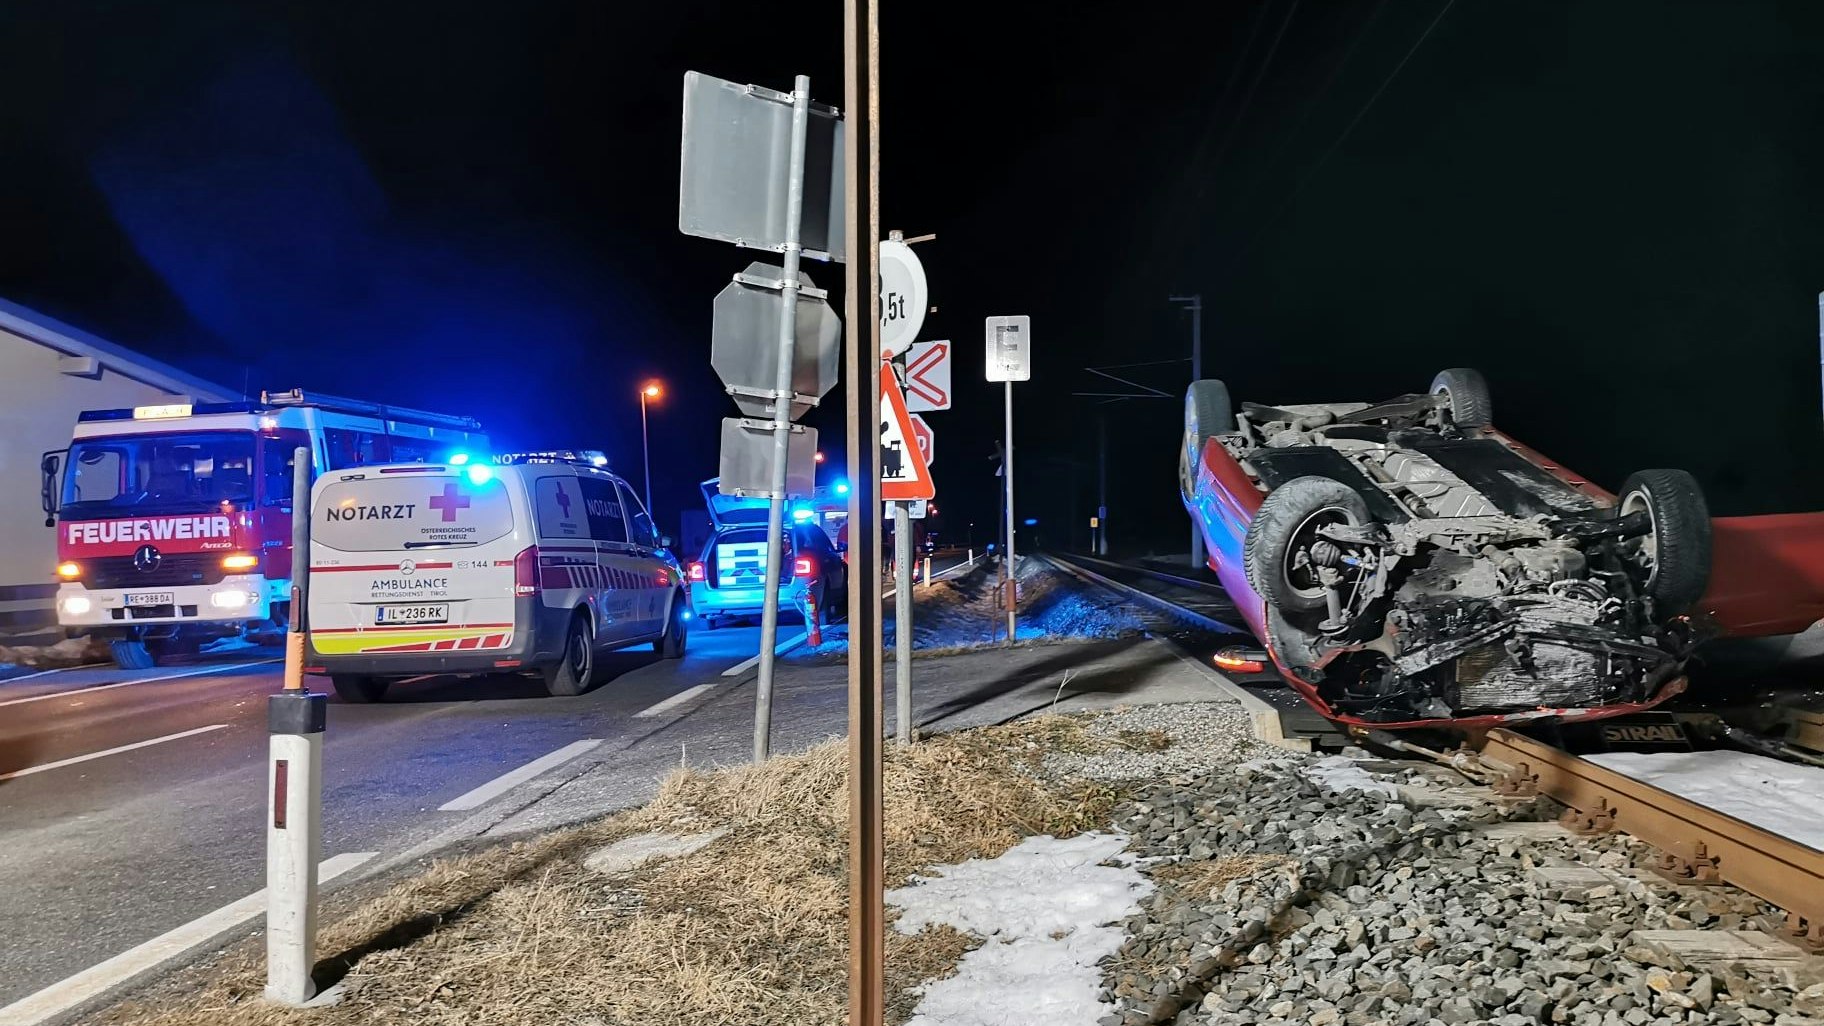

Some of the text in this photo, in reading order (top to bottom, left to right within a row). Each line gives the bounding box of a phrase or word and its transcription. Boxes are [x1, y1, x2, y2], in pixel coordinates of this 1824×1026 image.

[327, 504, 415, 522] NOTARZT
[68, 516, 230, 545] FEUERWEHR
[472, 561, 488, 569] 144
[371, 578, 447, 591] AMBULANCE
